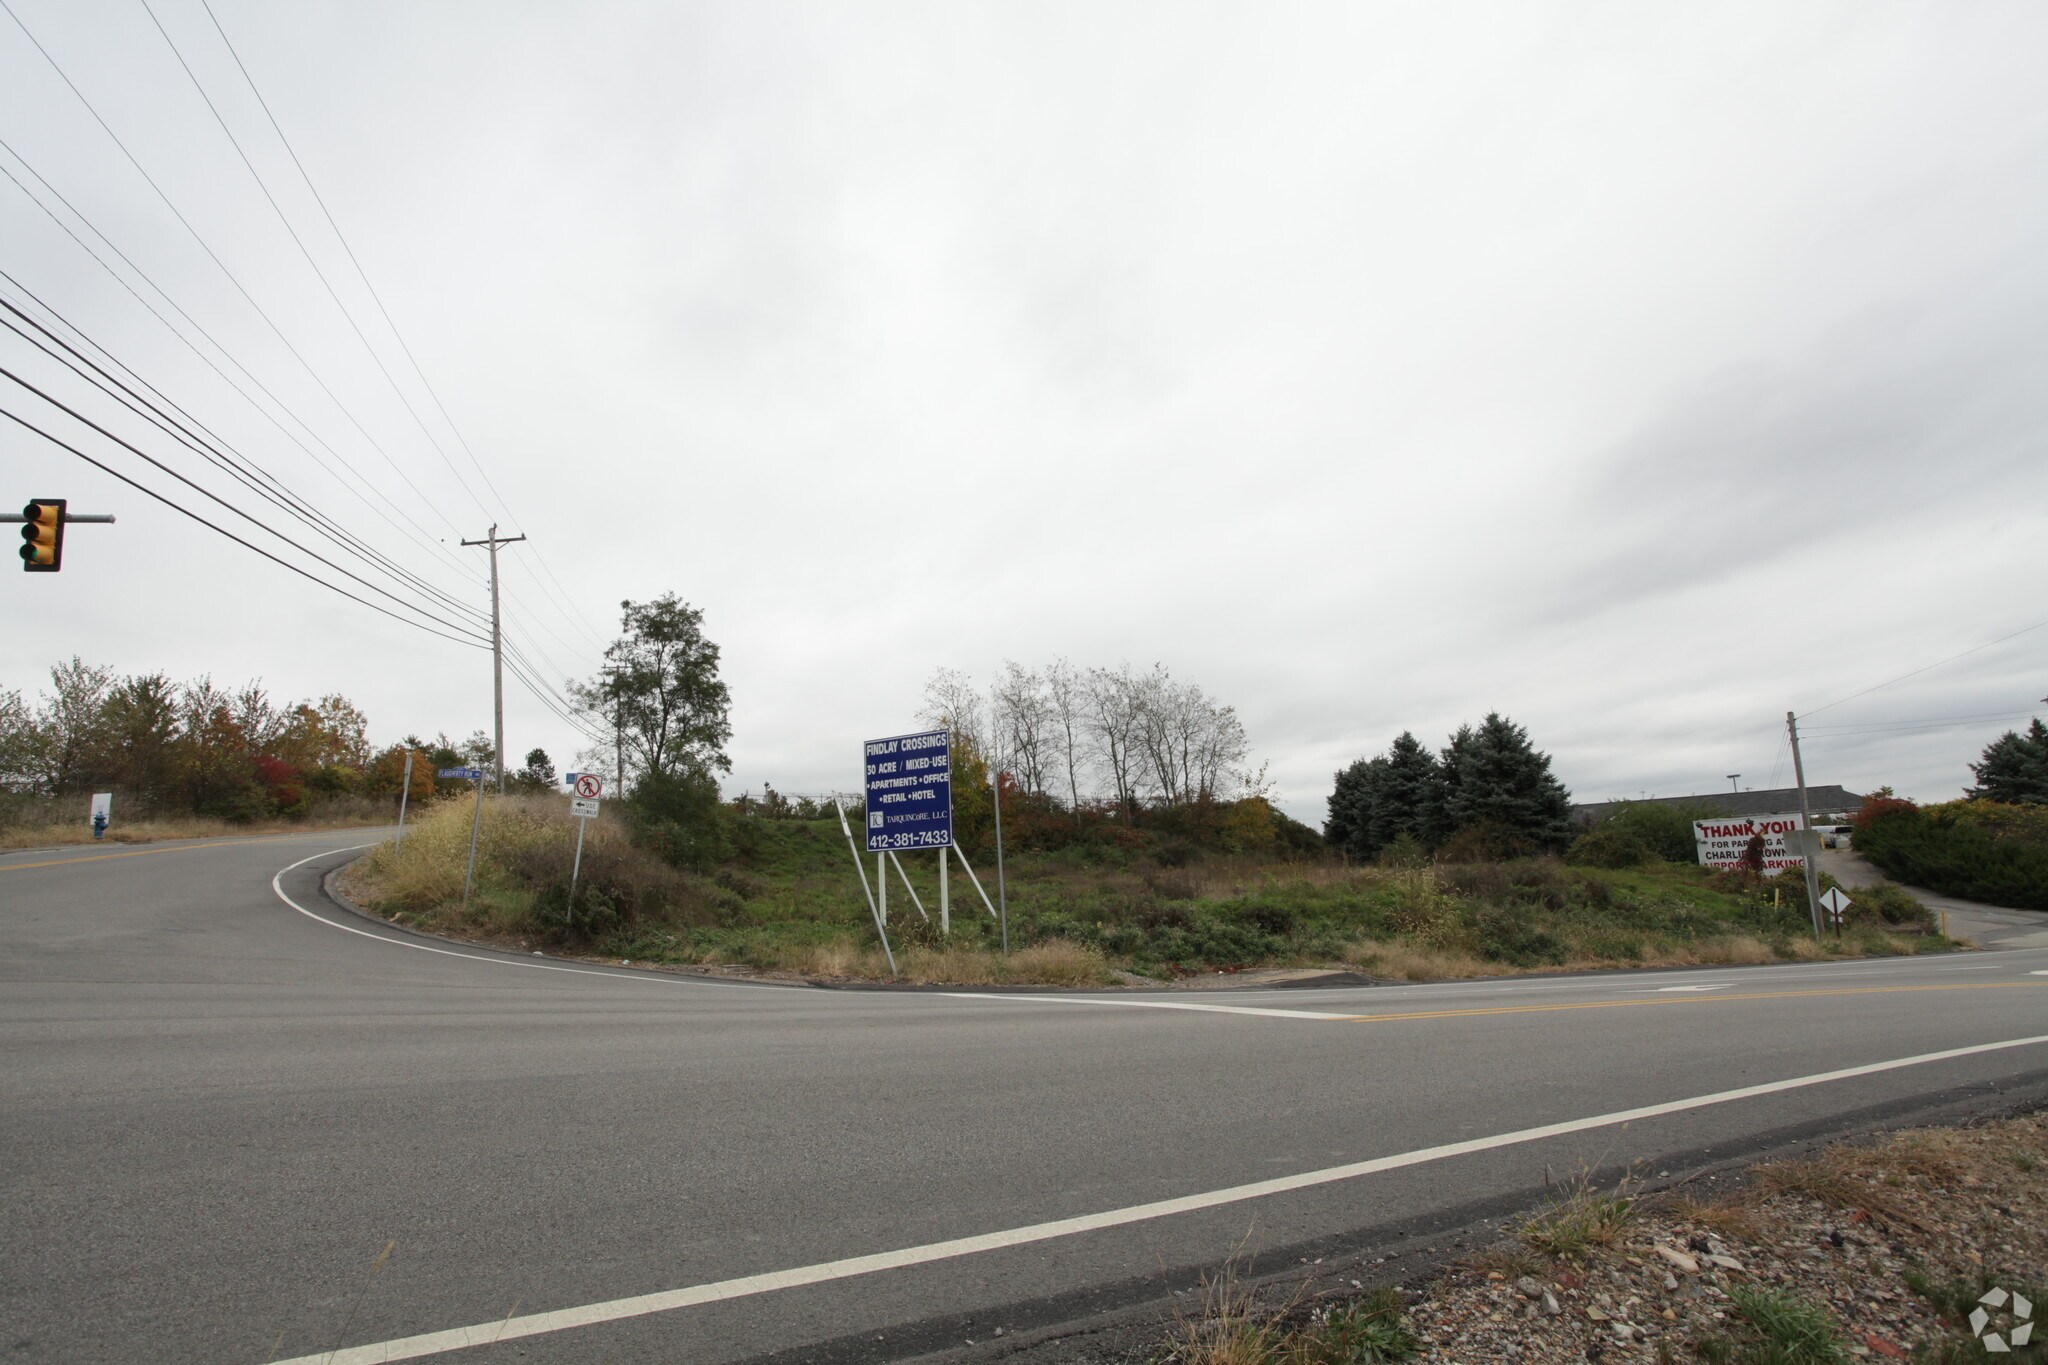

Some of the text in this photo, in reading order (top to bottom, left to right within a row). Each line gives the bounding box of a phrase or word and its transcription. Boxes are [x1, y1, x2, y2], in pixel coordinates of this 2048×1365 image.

[867, 733, 946, 756] FINDLAY CROSSINGS
[878, 761, 896, 774] ACRE
[906, 755, 947, 771] MIXED-USE
[871, 772, 949, 790] APARTMENTS OFFICE
[883, 789, 935, 804] RETAIL HOTEL
[932, 810, 947, 819] LLC
[1700, 820, 1795, 838] THANK YOU
[869, 829, 949, 848] 412-381-7433
[1711, 840, 1729, 848] FOR
[1762, 859, 1805, 869] ARKING
